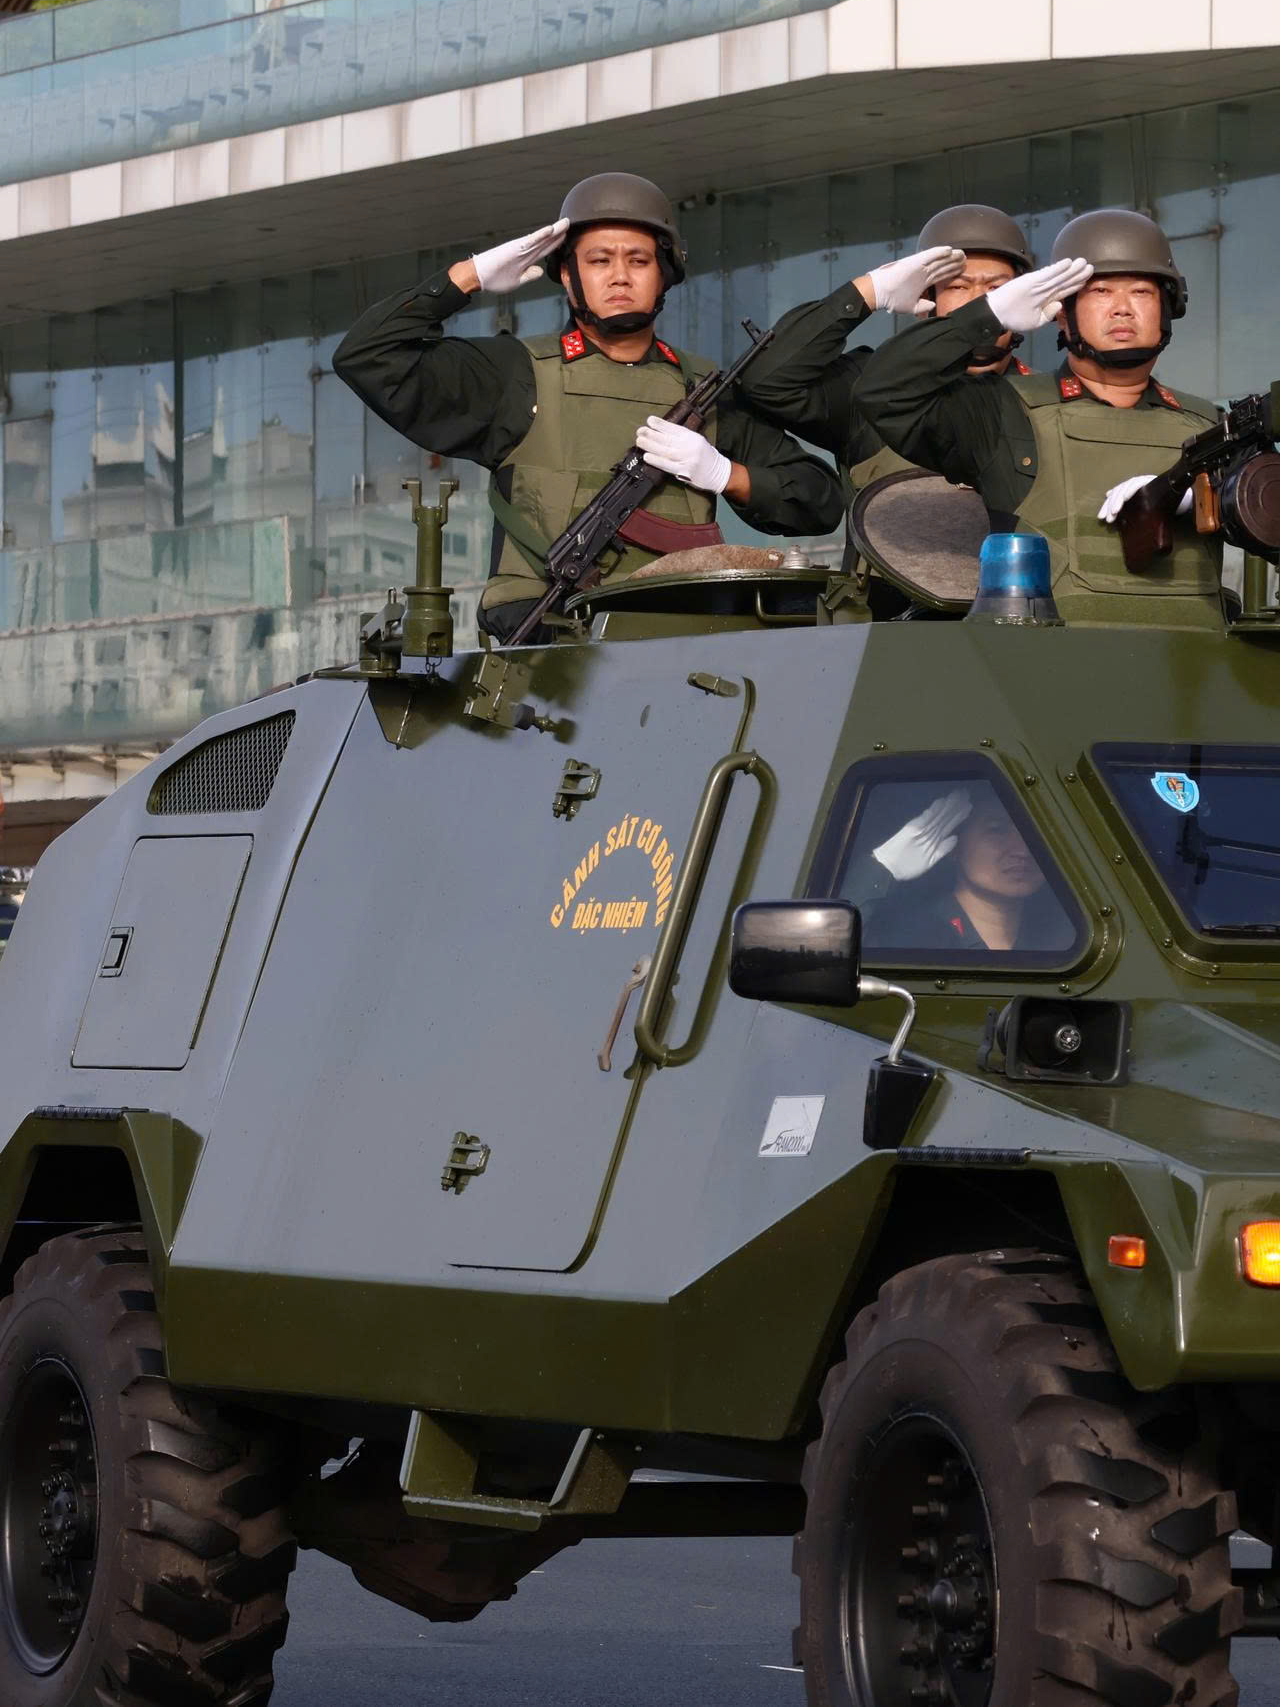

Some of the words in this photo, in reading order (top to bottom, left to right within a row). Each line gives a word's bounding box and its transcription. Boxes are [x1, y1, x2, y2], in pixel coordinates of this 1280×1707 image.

[550, 841, 600, 928] CẢNH
[605, 813, 640, 856] SÁT
[637, 819, 662, 854] CƠ
[572, 897, 602, 935] ĐẶC
[600, 896, 648, 934] NHIỆM
